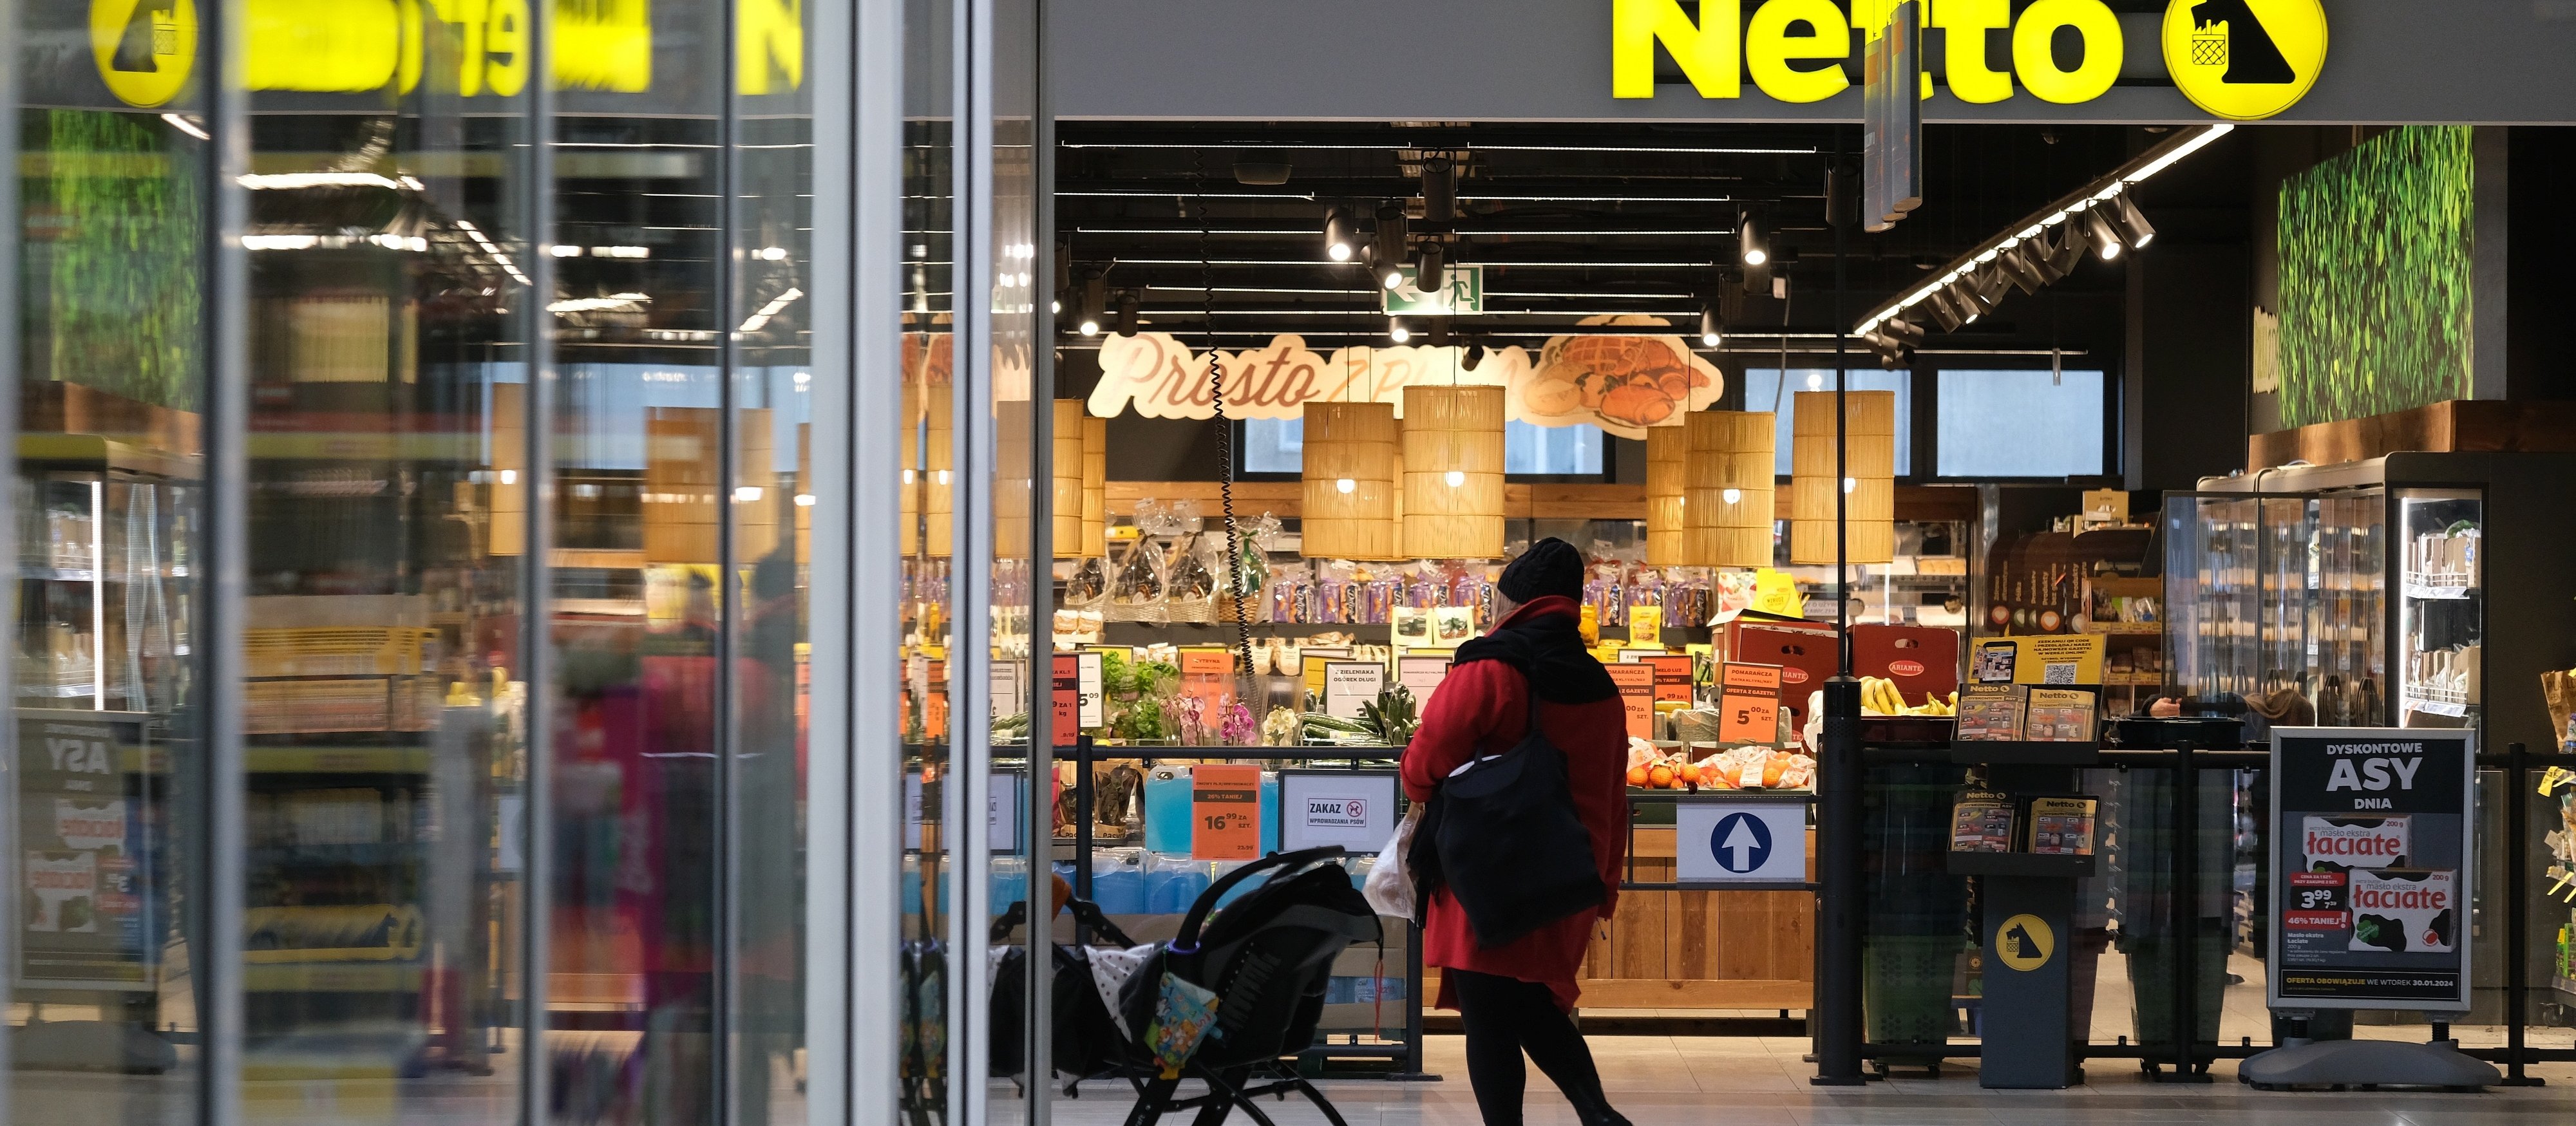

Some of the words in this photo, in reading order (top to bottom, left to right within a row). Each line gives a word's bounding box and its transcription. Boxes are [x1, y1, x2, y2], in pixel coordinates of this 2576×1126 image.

[1612, 0, 2123, 104] Neto
[1103, 333, 1321, 412] Prosto
[1783, 671, 1806, 680] RIANTE
[2327, 742, 2423, 755] DYSKONTOWE
[2326, 757, 2423, 792] ASY
[1309, 803, 1341, 814] ZAKAZ
[2354, 798, 2392, 810] DNIA
[2307, 831, 2401, 856] łaciate
[2354, 885, 2447, 910] łaciate
[2316, 977, 2366, 986] OBOWIĄZUJE
